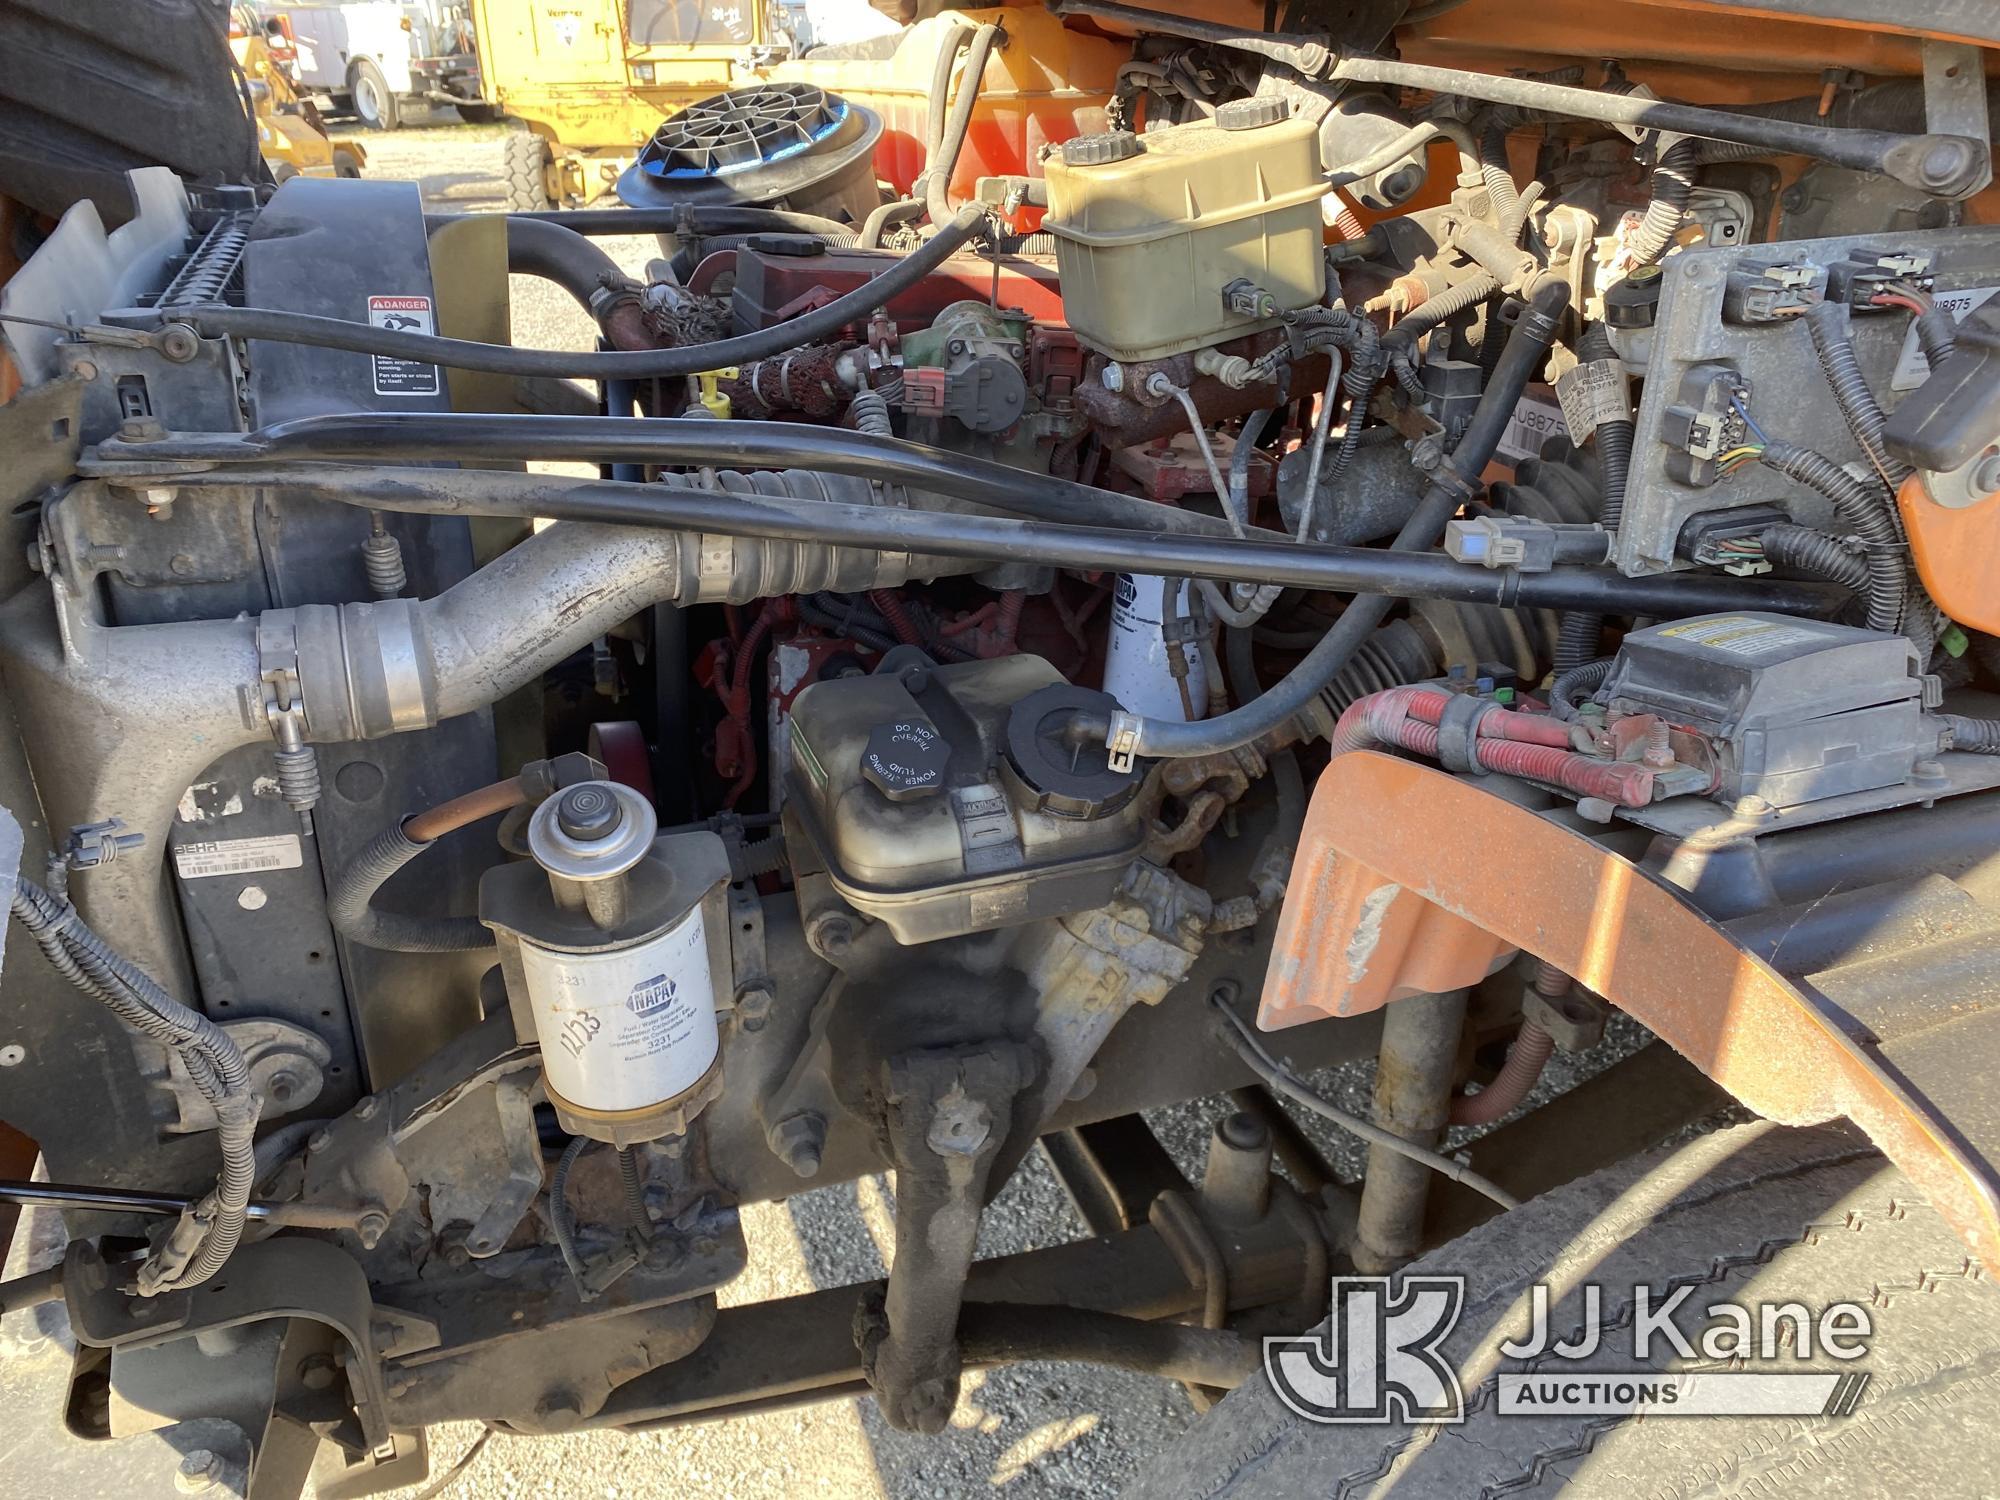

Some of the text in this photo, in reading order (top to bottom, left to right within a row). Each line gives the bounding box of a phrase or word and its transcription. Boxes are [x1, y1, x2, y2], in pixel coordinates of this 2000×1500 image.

[384, 301, 427, 309] DANGER
[895, 724, 934, 740] DO NOT
[892, 733, 930, 752] OVERFILL
[869, 754, 937, 785] POWER STEERING
[889, 763, 915, 776] FLUID
[175, 842, 218, 855] BEHR
[634, 981, 671, 1010] NAPA
[642, 1018, 660, 1028] Water
[560, 1010, 601, 1059] 12/23
[648, 1033, 671, 1049] 3231
